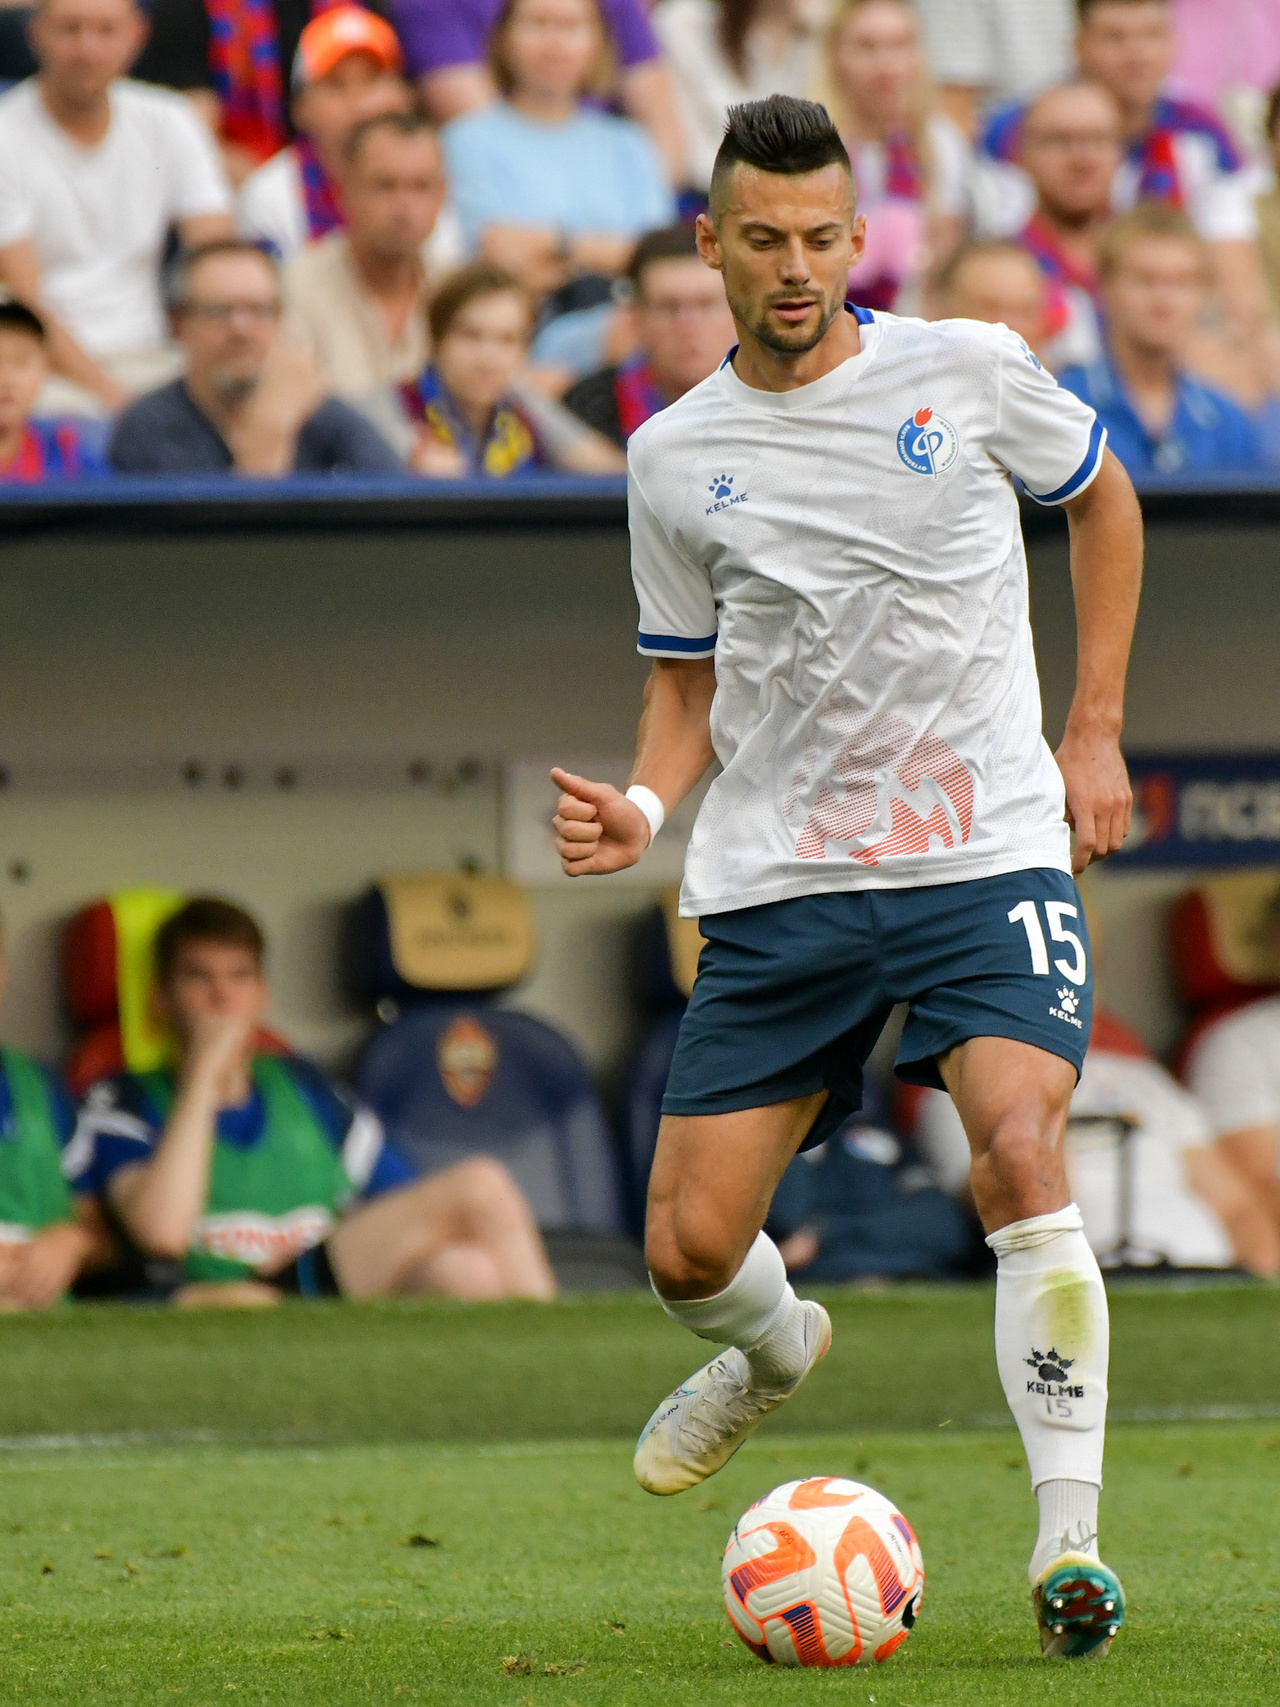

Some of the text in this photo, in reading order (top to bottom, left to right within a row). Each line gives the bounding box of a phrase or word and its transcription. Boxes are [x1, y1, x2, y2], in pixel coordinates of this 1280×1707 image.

[705, 492, 749, 516] KELME
[1007, 900, 1087, 986] 15
[1049, 1006, 1083, 1030] KELME
[1026, 1381, 1084, 1398] KELME
[1046, 1398, 1072, 1418] 15
